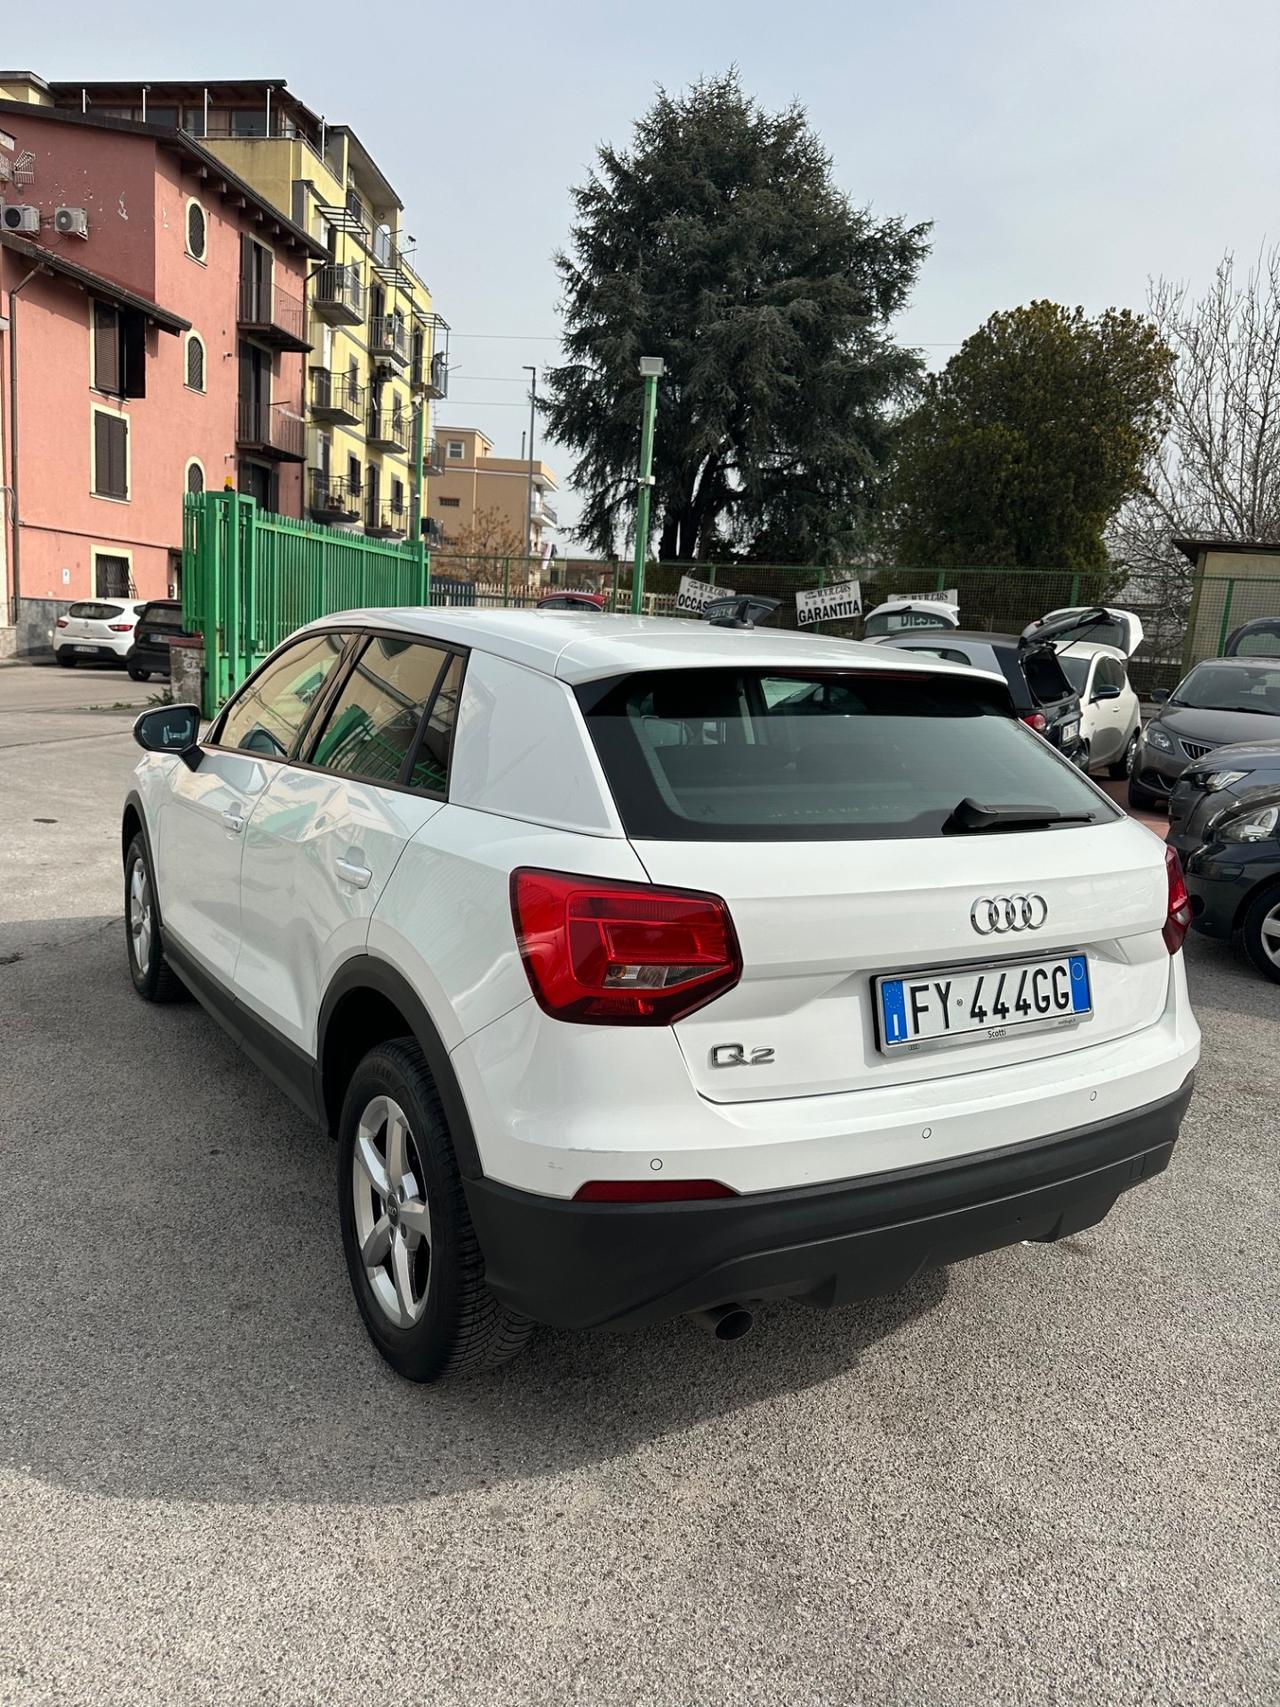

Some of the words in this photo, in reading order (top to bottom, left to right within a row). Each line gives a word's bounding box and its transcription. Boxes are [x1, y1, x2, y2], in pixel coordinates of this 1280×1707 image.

[678, 594, 709, 613] OCCAS
[799, 600, 861, 623] GARANTITA
[909, 981, 952, 1035] FY
[970, 965, 1071, 1024] 444GG
[987, 1027, 1007, 1038] Scotti
[710, 1042, 775, 1069] Q2
